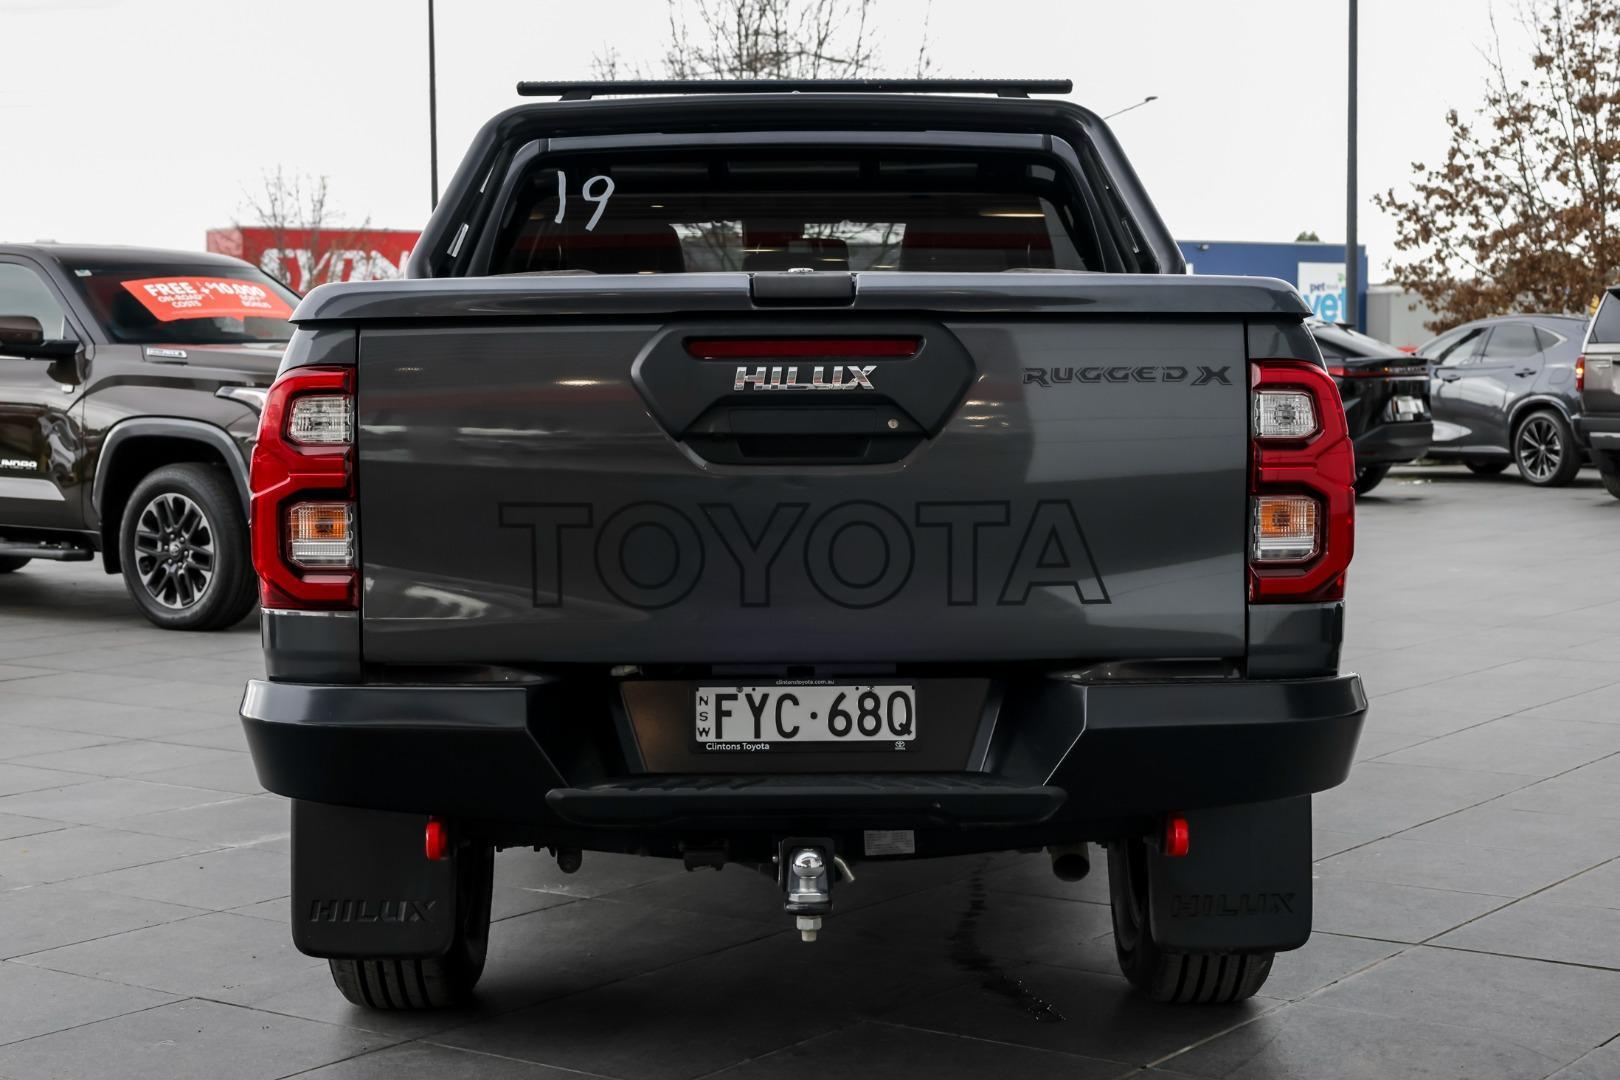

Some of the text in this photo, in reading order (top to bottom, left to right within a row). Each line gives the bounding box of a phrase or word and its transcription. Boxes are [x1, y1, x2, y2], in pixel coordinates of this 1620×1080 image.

[555, 170, 615, 231] 19
[143, 282, 198, 297] FREE
[734, 365, 877, 391] HILUX
[1023, 366, 1233, 388] RUGGED X
[500, 499, 1112, 610] TOYOTA
[706, 742, 770, 752] Clintons Toyota
[310, 900, 437, 922] HILUX
[1170, 892, 1297, 918] HILUX
